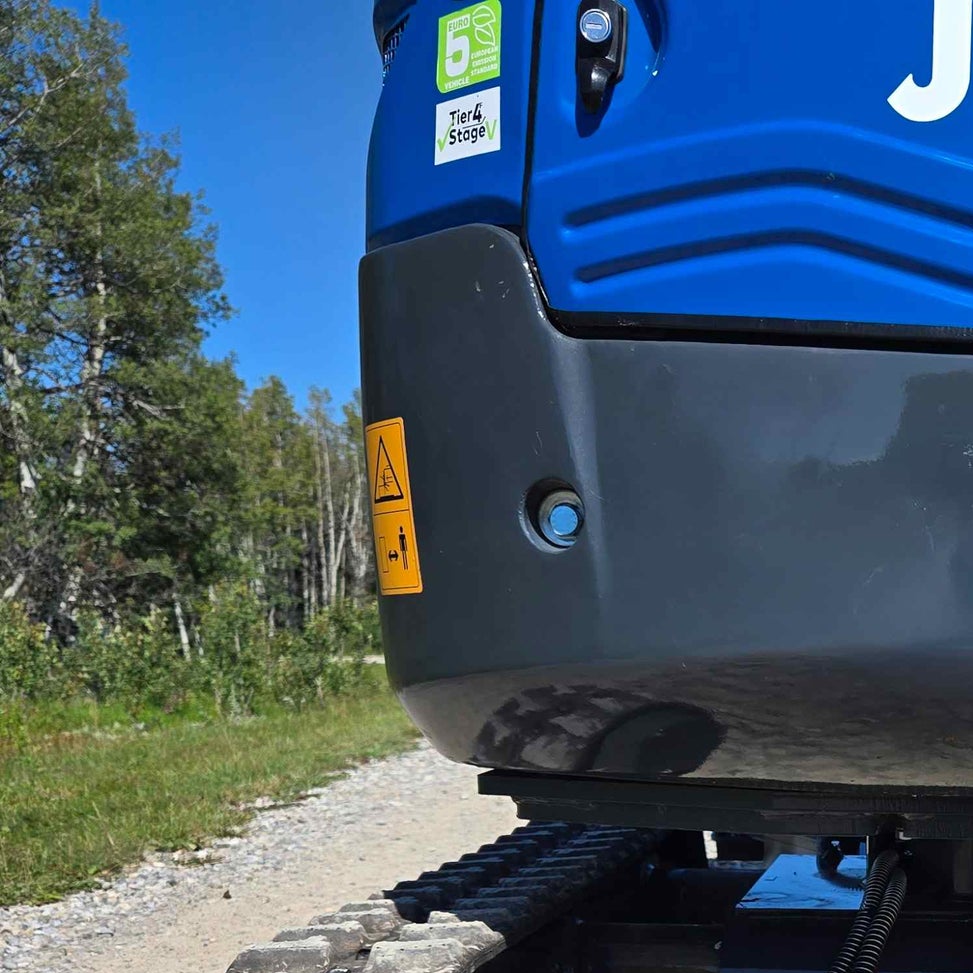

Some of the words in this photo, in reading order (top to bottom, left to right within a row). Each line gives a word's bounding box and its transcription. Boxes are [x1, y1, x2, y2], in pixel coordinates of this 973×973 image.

[448, 16, 469, 32] EURO
[445, 30, 470, 77] 5
[471, 63, 498, 77] STANDARD
[444, 76, 470, 91] VEHICLE
